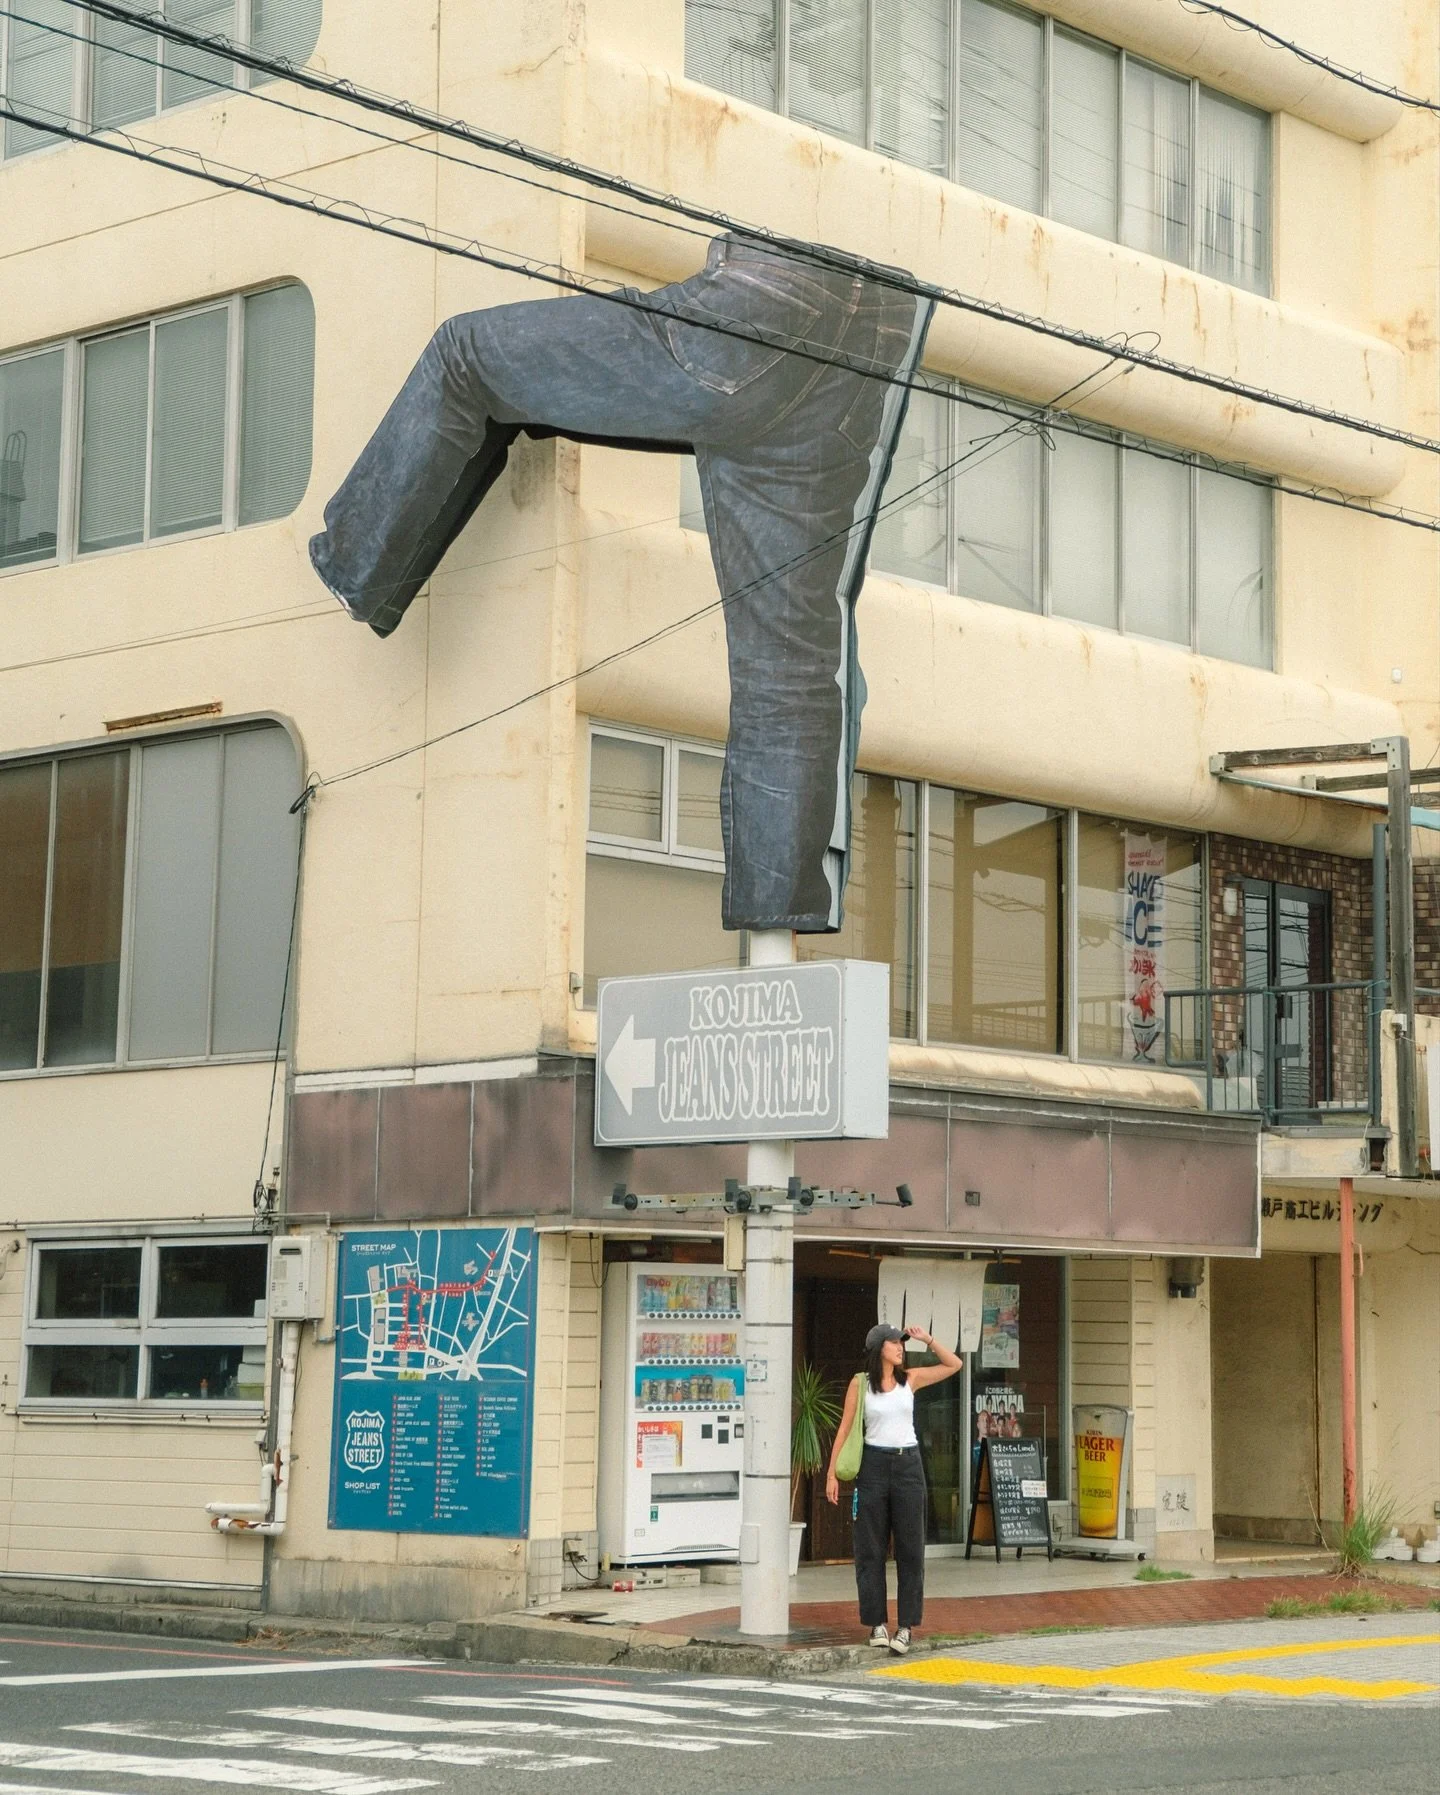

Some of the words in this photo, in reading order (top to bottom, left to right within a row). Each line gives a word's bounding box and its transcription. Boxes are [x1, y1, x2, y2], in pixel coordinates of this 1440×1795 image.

[690, 980, 802, 1030] KOJIMA
[658, 1034, 738, 1123] JEANS
[738, 1027, 834, 1120] STREET
[351, 1244, 380, 1252] STREET
[380, 1243, 397, 1251] MAP
[351, 1417, 381, 1429] KOJIMA
[351, 1431, 379, 1447] JEANS
[1079, 1436, 1116, 1451] LAGER
[347, 1448, 381, 1464] STREET
[1084, 1450, 1107, 1462] BEER
[344, 1481, 365, 1489] SHOP
[365, 1482, 381, 1490] LIST
